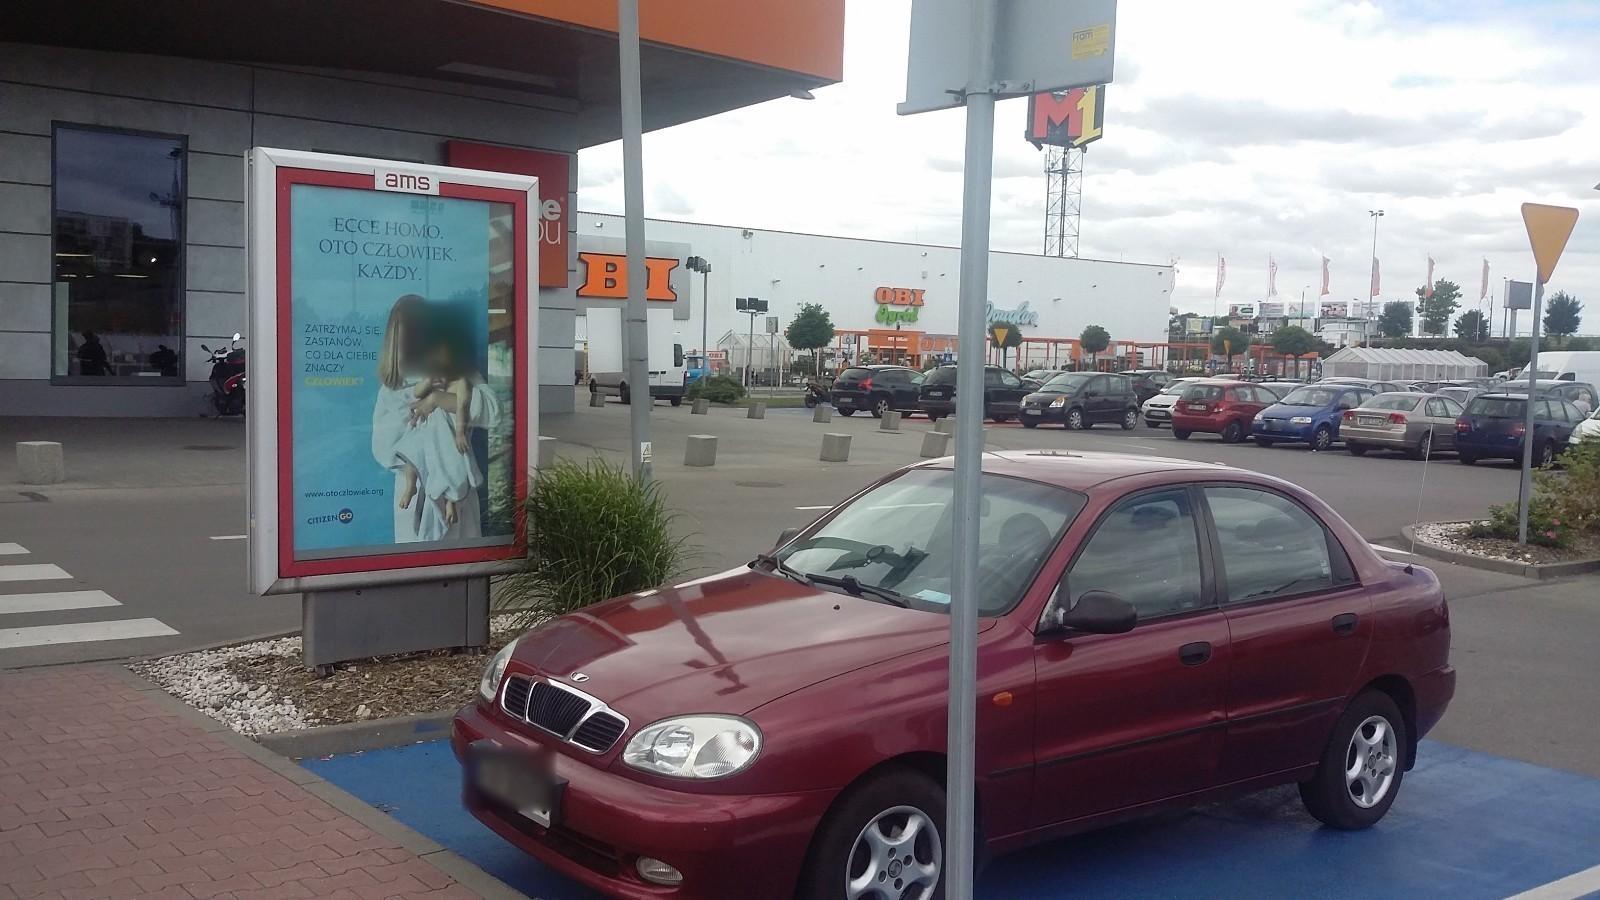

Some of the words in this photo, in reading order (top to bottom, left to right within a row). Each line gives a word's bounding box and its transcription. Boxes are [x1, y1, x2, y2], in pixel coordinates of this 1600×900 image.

[1032, 86, 1102, 147] M1
[385, 172, 430, 191] ams
[334, 217, 380, 235] ECCE
[385, 222, 444, 240] HOMO.
[319, 238, 358, 256] OTO
[362, 241, 457, 262] CZŁOWIEK.
[358, 262, 422, 281] KAŻDY.
[875, 286, 926, 306] OBI
[305, 324, 362, 335] ZATRZYMAJ
[305, 350, 321, 360] CO
[324, 350, 344, 360] DLA
[346, 351, 377, 361] CIEBIE
[305, 363, 345, 373] ZNACZY
[304, 487, 384, 498] www.otoczlowiek.org
